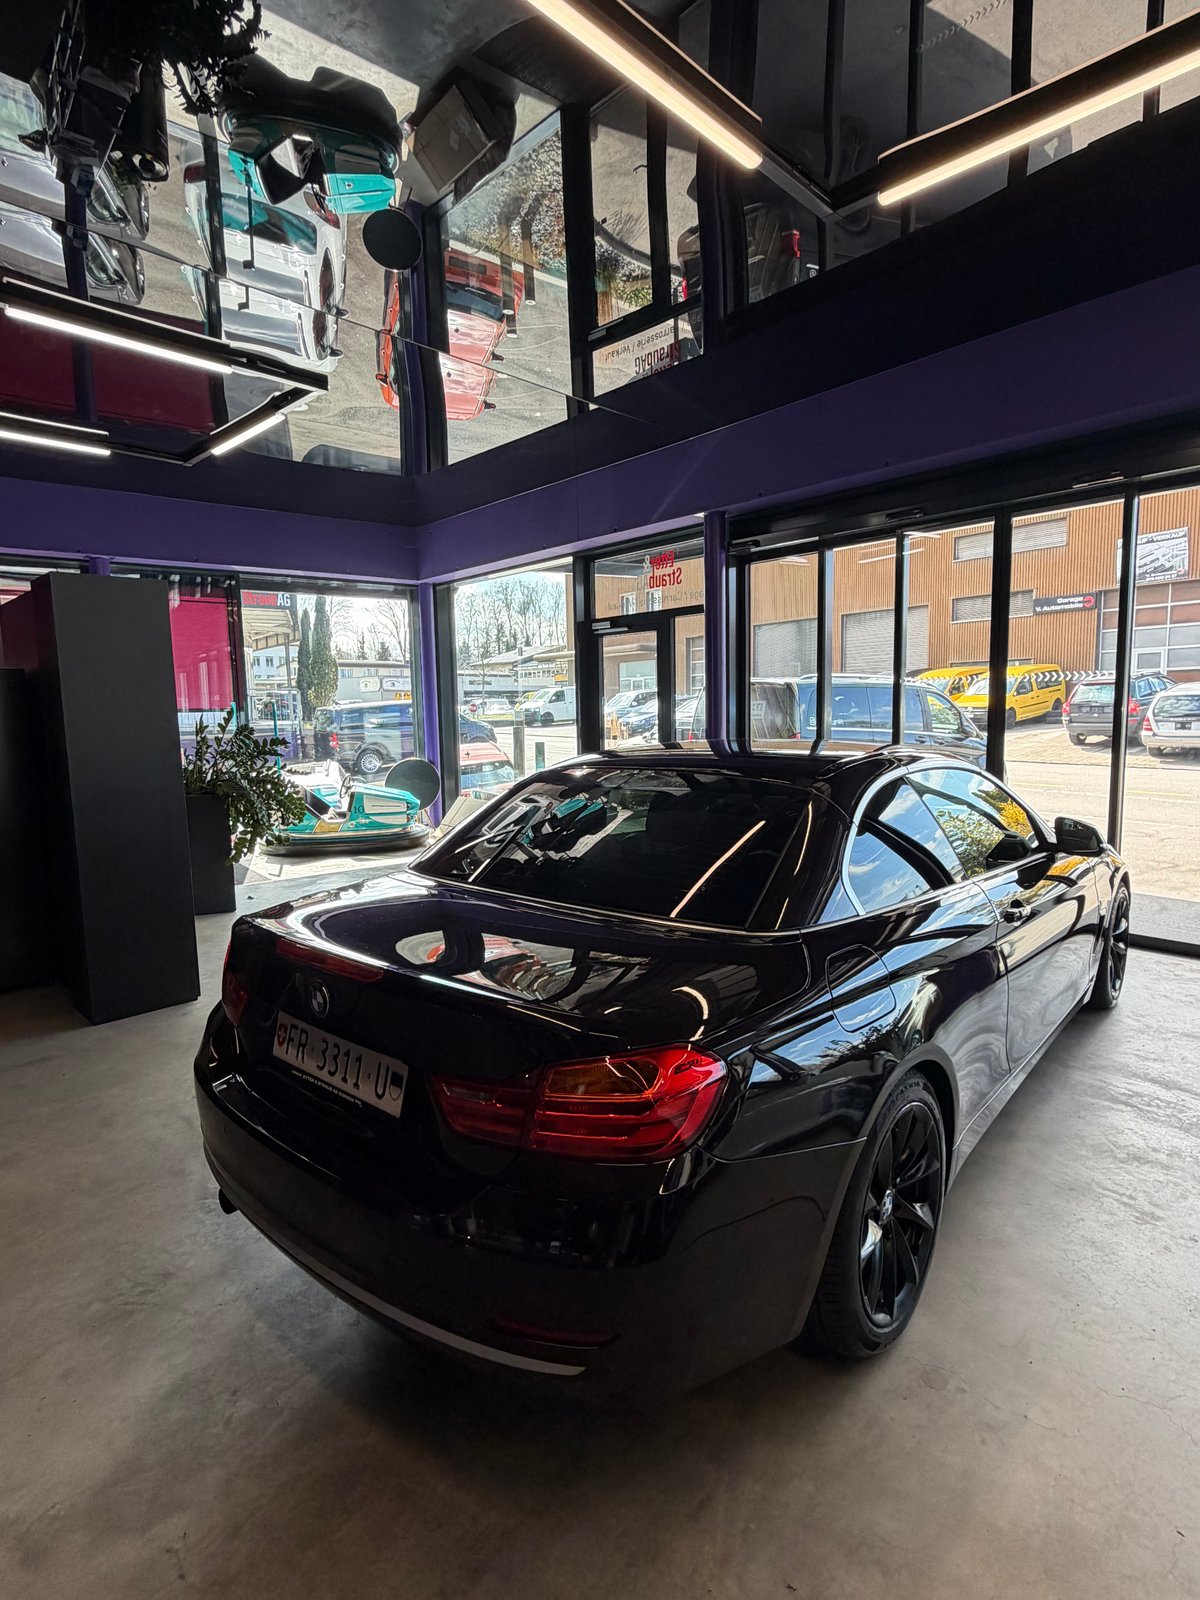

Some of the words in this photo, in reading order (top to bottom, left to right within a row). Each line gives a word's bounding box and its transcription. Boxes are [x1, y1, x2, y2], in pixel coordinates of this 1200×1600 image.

[637, 326, 675, 350] arrosserie
[1057, 596, 1083, 604] Garage
[354, 805, 364, 814] 10
[285, 1023, 310, 1064] FR
[316, 1039, 364, 1090] 3311
[375, 1062, 389, 1099] U
